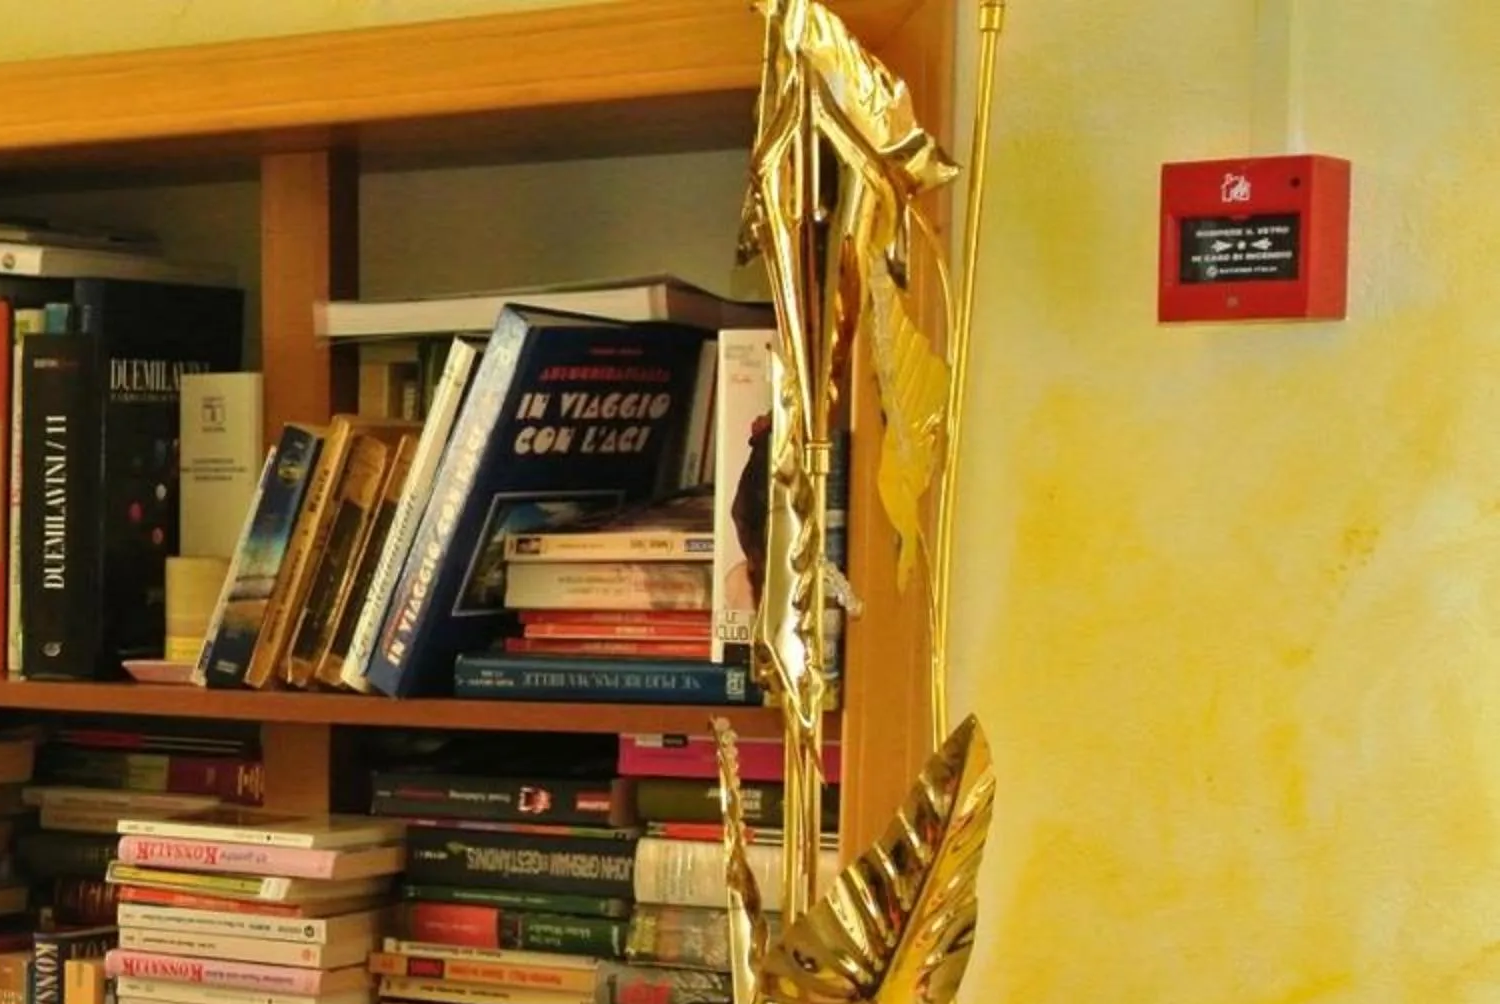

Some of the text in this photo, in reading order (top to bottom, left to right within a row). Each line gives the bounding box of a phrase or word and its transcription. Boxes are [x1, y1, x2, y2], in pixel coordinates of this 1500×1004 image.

[515, 392, 672, 420] IN VIAGGIO
[514, 427, 653, 455] CON L'ACI
[43, 455, 67, 589] DUEMILAVINI
[398, 541, 442, 633] VIAGGIO
[135, 841, 220, 866] KONSALIK
[120, 956, 204, 982] KONSALIK
